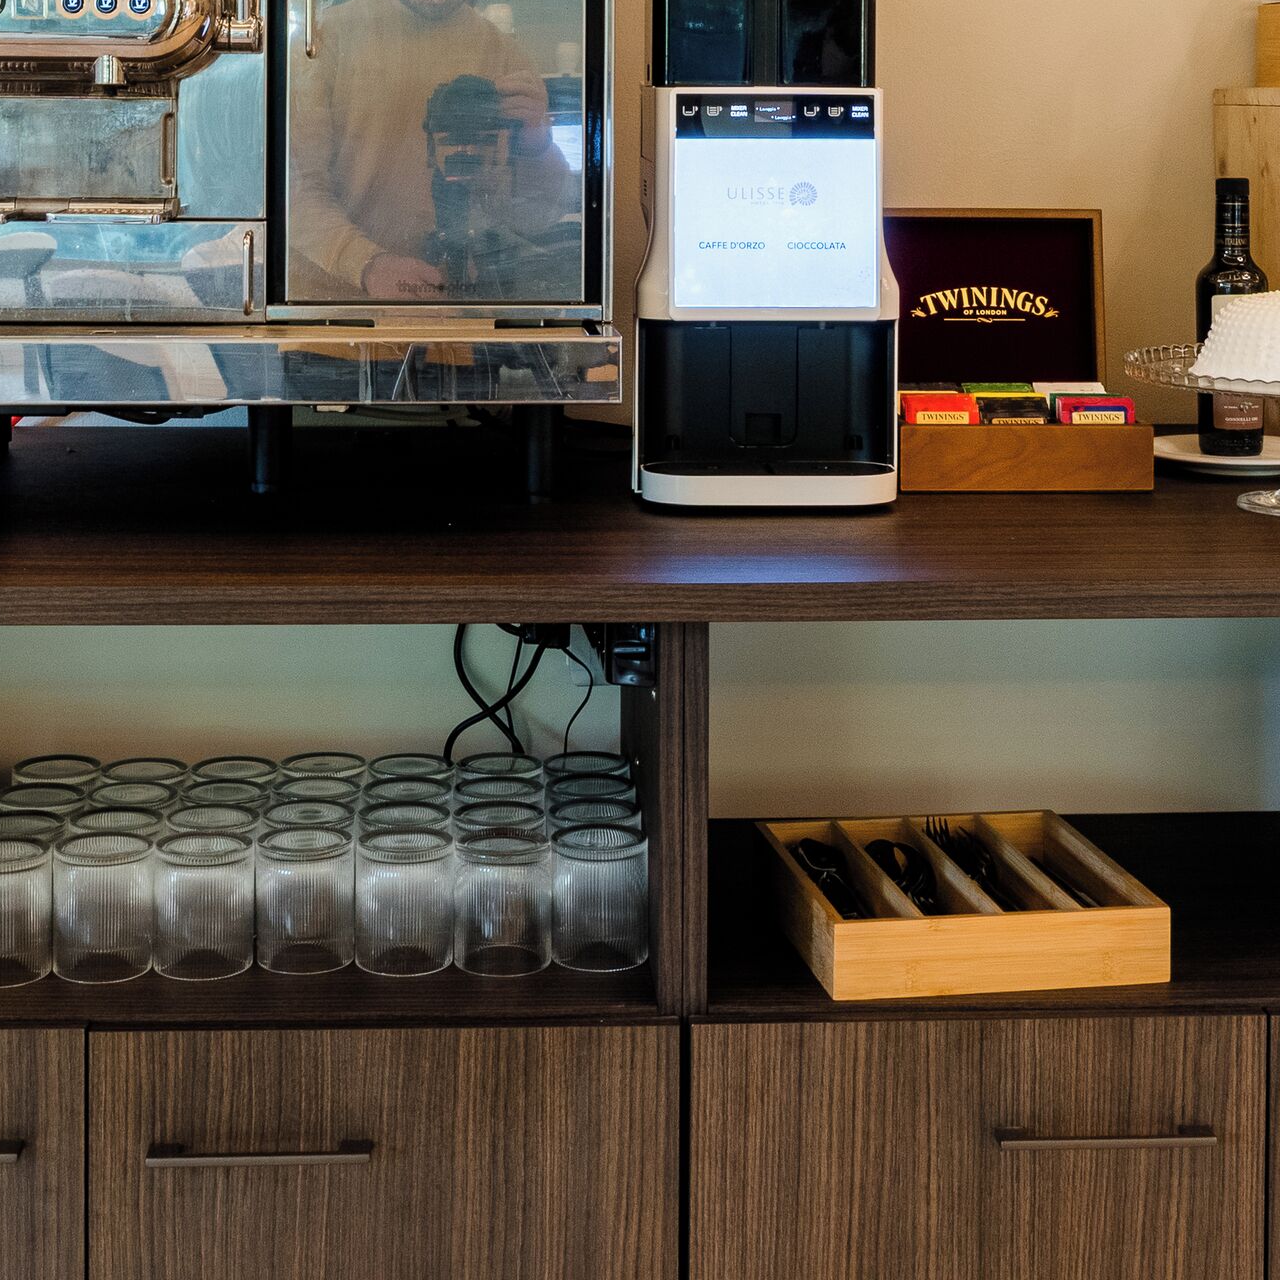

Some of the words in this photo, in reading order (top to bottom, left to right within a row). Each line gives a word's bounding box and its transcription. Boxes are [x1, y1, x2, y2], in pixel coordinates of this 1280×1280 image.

[727, 187, 785, 200] ULISSE
[698, 241, 728, 250] CAFFE
[730, 241, 766, 250] D'ORZO
[787, 241, 847, 250] CIOCCOLATA
[920, 286, 1049, 316] TWININGS
[922, 413, 964, 421] TWININGS
[1078, 413, 1121, 421] TWININGS
